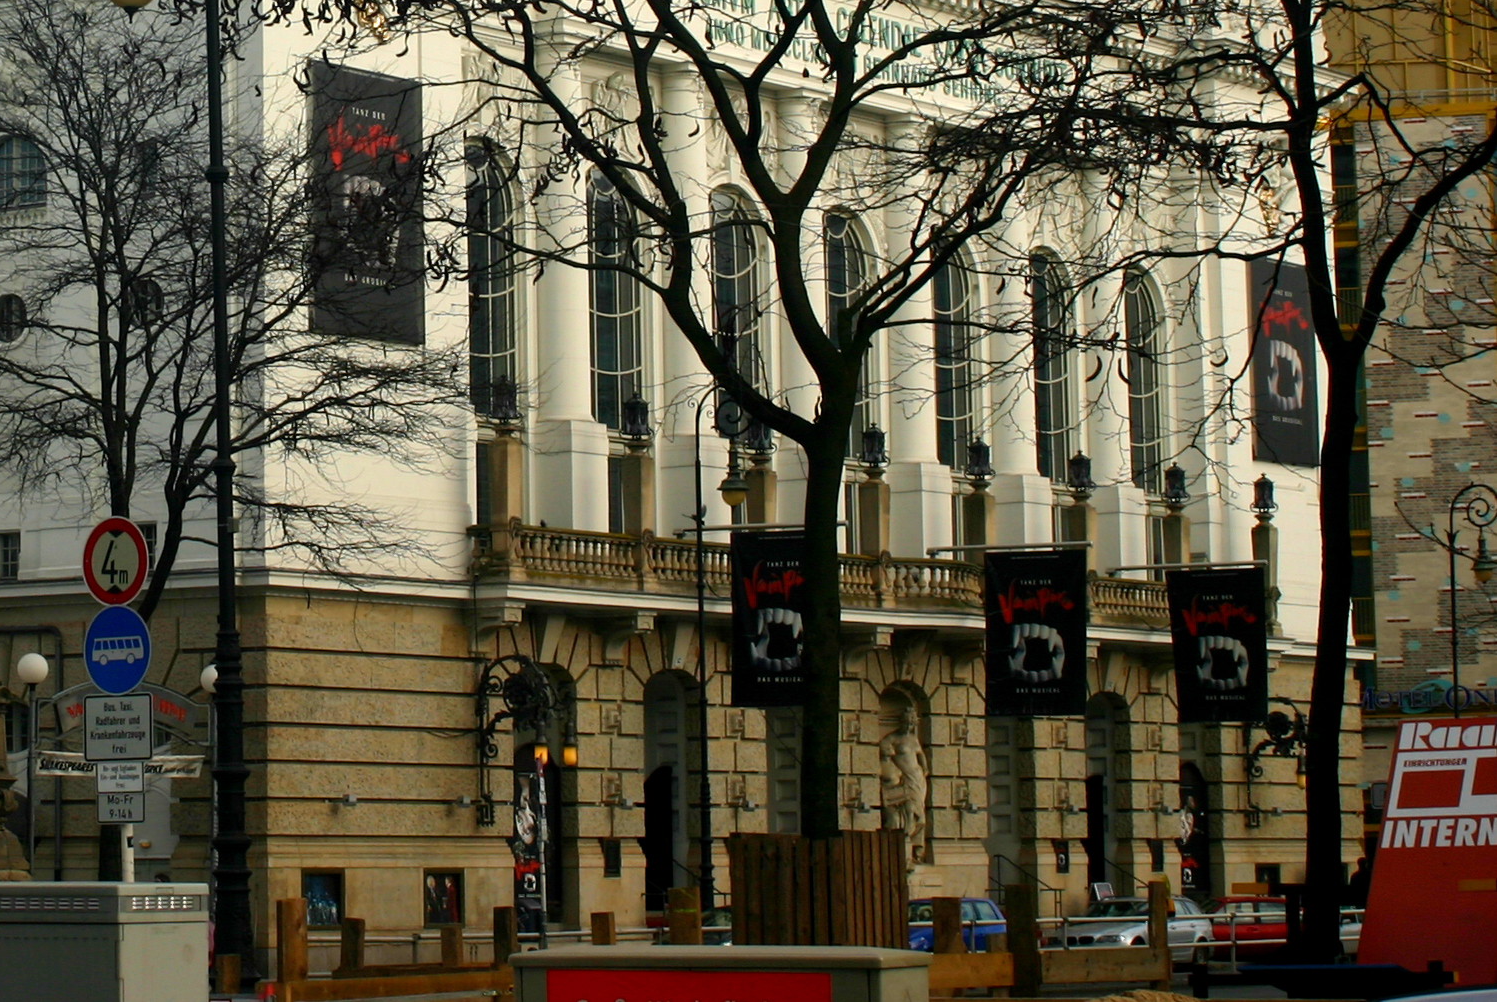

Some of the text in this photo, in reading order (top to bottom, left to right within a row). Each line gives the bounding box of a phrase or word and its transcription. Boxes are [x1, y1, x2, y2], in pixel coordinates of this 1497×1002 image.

[128, 715, 141, 725] und
[1398, 721, 1497, 750] Raa
[112, 744, 127, 754] frei
[107, 794, 134, 805] Mo-Fr
